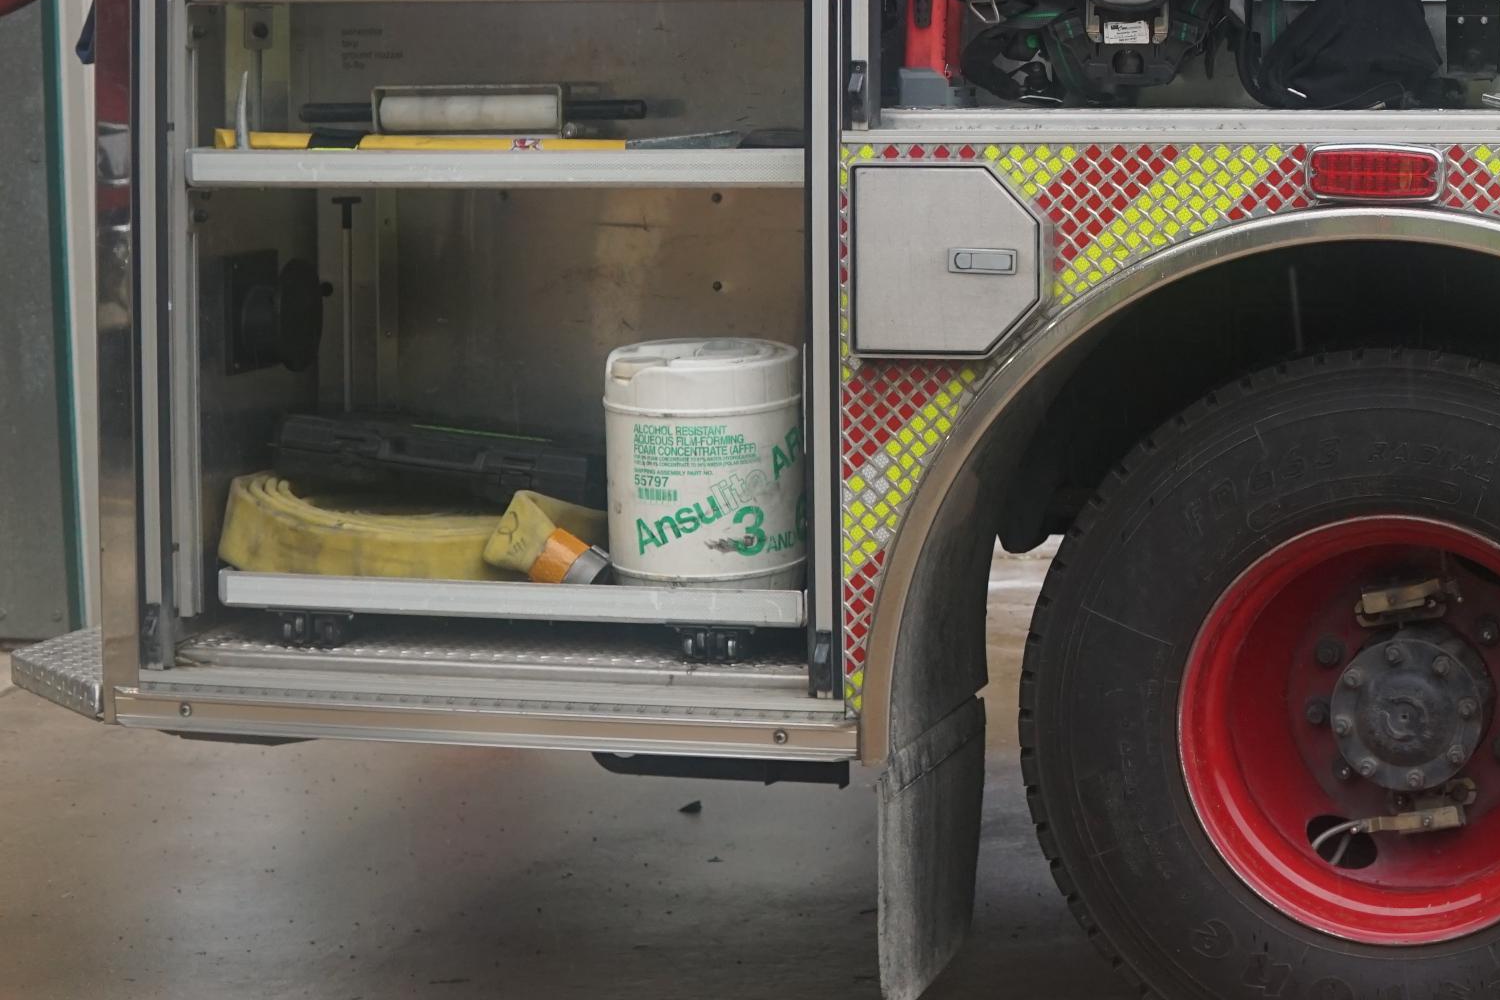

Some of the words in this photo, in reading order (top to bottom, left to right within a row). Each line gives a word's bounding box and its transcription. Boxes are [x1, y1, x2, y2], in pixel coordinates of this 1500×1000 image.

[633, 424, 673, 436] ALCOHOL
[675, 425, 727, 436] RESISTANT
[633, 434, 674, 446] AQUEOUS
[676, 434, 744, 446] FILM-FORMING
[633, 444, 656, 456] FOAM
[658, 445, 728, 457] CONCENTRATE
[634, 474, 669, 487] 55797
[636, 468, 767, 556] Ansulite
[733, 504, 767, 557] 3
